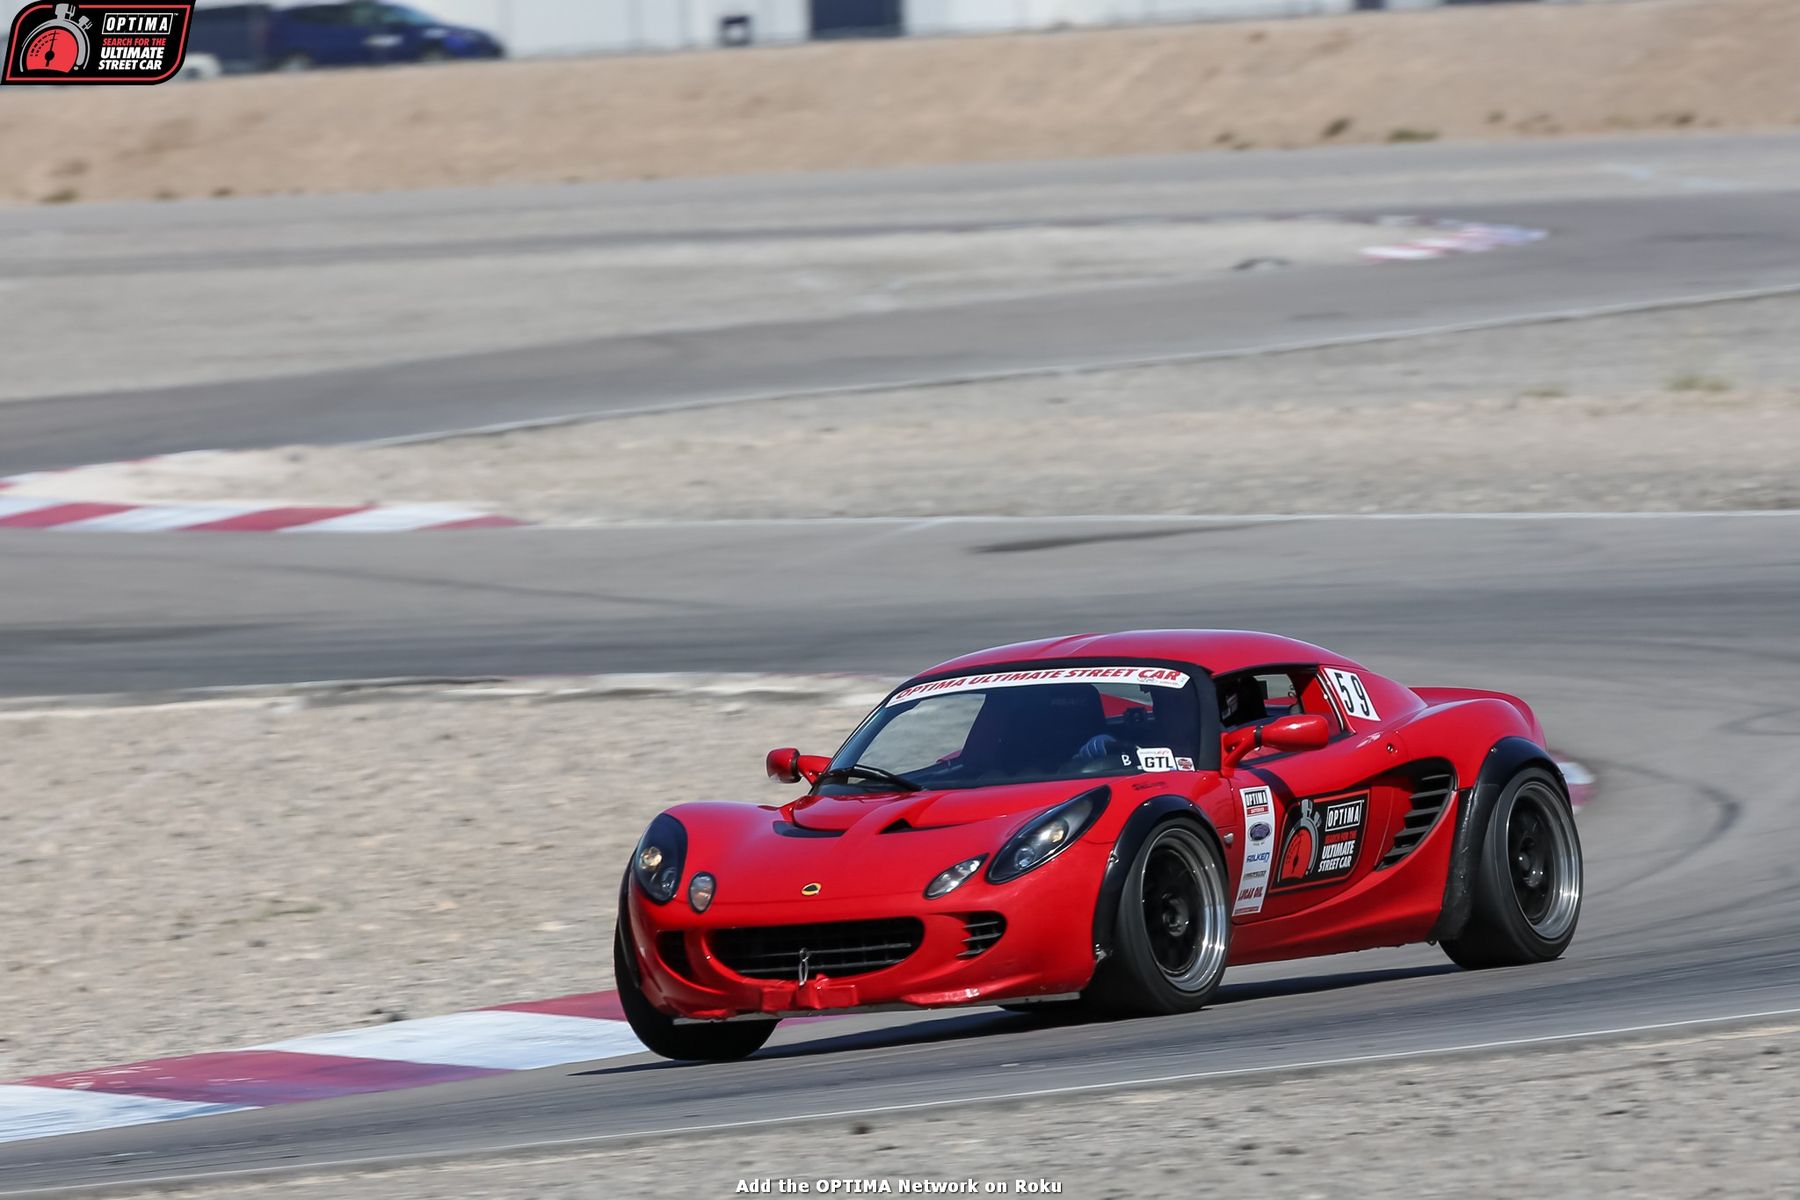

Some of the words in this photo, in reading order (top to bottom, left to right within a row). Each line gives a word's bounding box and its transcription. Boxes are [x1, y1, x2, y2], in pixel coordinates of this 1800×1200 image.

[895, 678, 966, 700] OPTIMA
[968, 670, 1065, 685] ULTIMATE
[1063, 668, 1138, 679] STREET
[1137, 668, 1181, 681] CAR
[1333, 672, 1370, 717] 59
[1144, 756, 1174, 769] GTL
[1245, 791, 1268, 807] OPTIMA
[1327, 805, 1360, 828] OPTIMA
[1321, 840, 1356, 860] ULTIMATE
[1318, 857, 1341, 873] STREET
[1339, 855, 1352, 869] CAR
